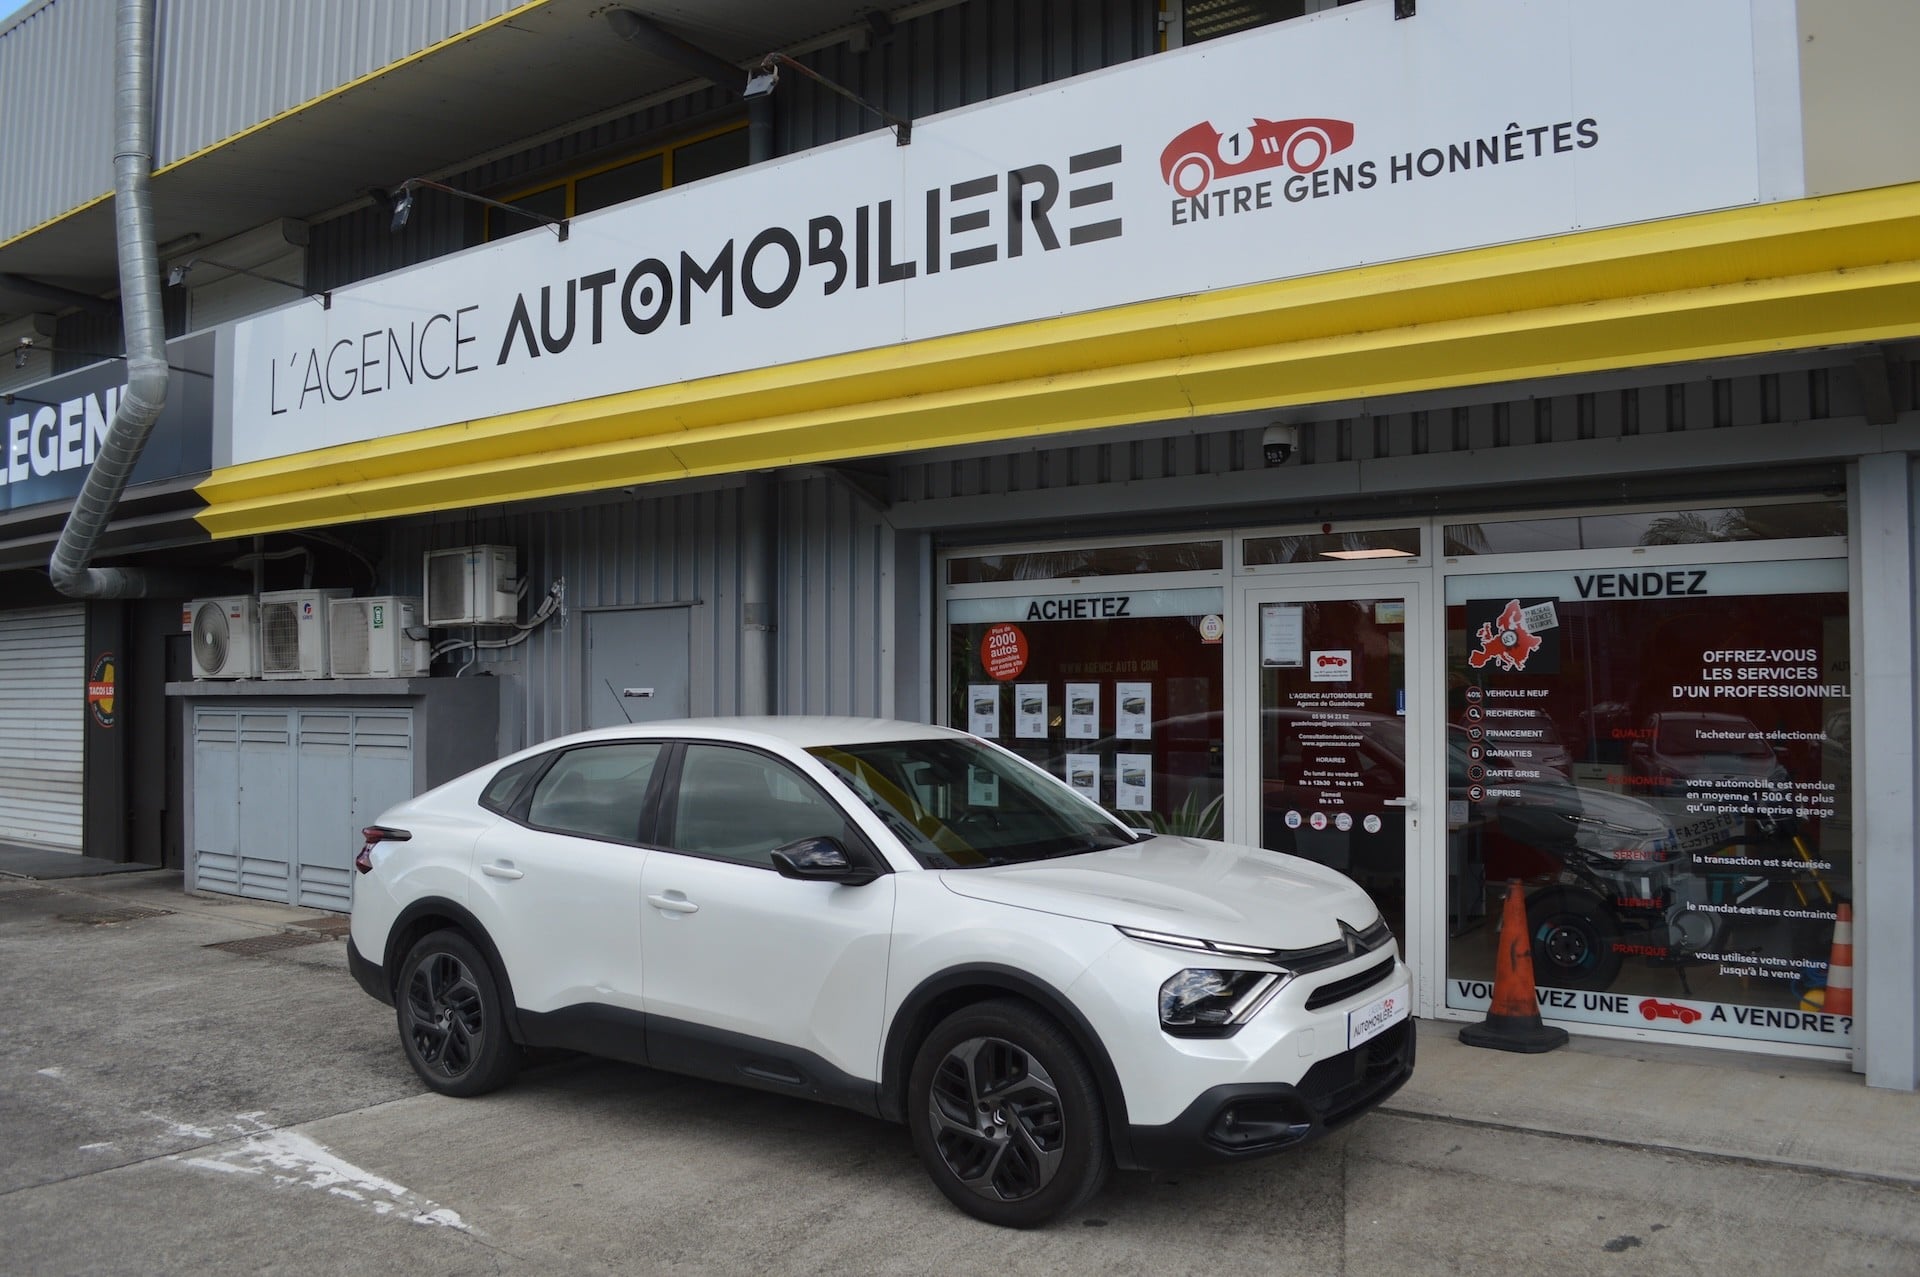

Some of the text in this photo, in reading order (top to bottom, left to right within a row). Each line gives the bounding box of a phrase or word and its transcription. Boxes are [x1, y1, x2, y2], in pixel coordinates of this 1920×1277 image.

[1228, 132, 1240, 157] 1
[1171, 117, 1600, 226] ENTRE GENS HONNÊTES
[270, 144, 1123, 416] L'AGENCE AUTOMOBILIERE
[1573, 570, 1708, 599] VENDEZ
[1027, 597, 1130, 620] ACHETEZ
[989, 631, 1017, 649] 2000
[990, 644, 1018, 658] autos
[1702, 649, 1817, 663] OFFREZ-VOUS
[1702, 667, 1818, 681] LES SERVICES
[1289, 692, 1373, 700] L'AGENCE AUTOMOBILIERE
[1485, 689, 1550, 697] VEHICULE NEUF
[1672, 684, 1851, 698] D'UN PROFESSIONNEL
[1296, 700, 1319, 708] Agence
[1328, 700, 1365, 708] Guadeloupe
[1485, 710, 1536, 718] RECHERCHE
[1485, 729, 1544, 738] FINANCEMENT
[1695, 730, 1828, 741] l'acheteur est sélectionné
[1486, 750, 1533, 758] GARANTIES
[1486, 770, 1541, 779] CARTE GRISE
[1686, 779, 1835, 790] votre automobile est vendue
[1486, 789, 1521, 798] REPRISE
[1686, 791, 1835, 805] en moyenne 1 500 € de plus
[1718, 804, 1739, 814] prix
[1740, 804, 1755, 814] de
[1757, 805, 1794, 816] reprise
[1796, 807, 1835, 818] garage
[1692, 853, 1832, 870] la transaction est sécurisée
[1686, 901, 1838, 921] le mandat est sans contrainte
[1612, 943, 1669, 958] PRATIQUE
[1695, 952, 1828, 970] vous utilisez votre voiture
[1759, 967, 1769, 978] la
[1770, 969, 1801, 980] vente
[1535, 988, 1577, 1009] VEZ
[1583, 993, 1629, 1014] UNE
[1710, 1005, 1727, 1022] A
[1733, 1006, 1835, 1033] VENDRE
